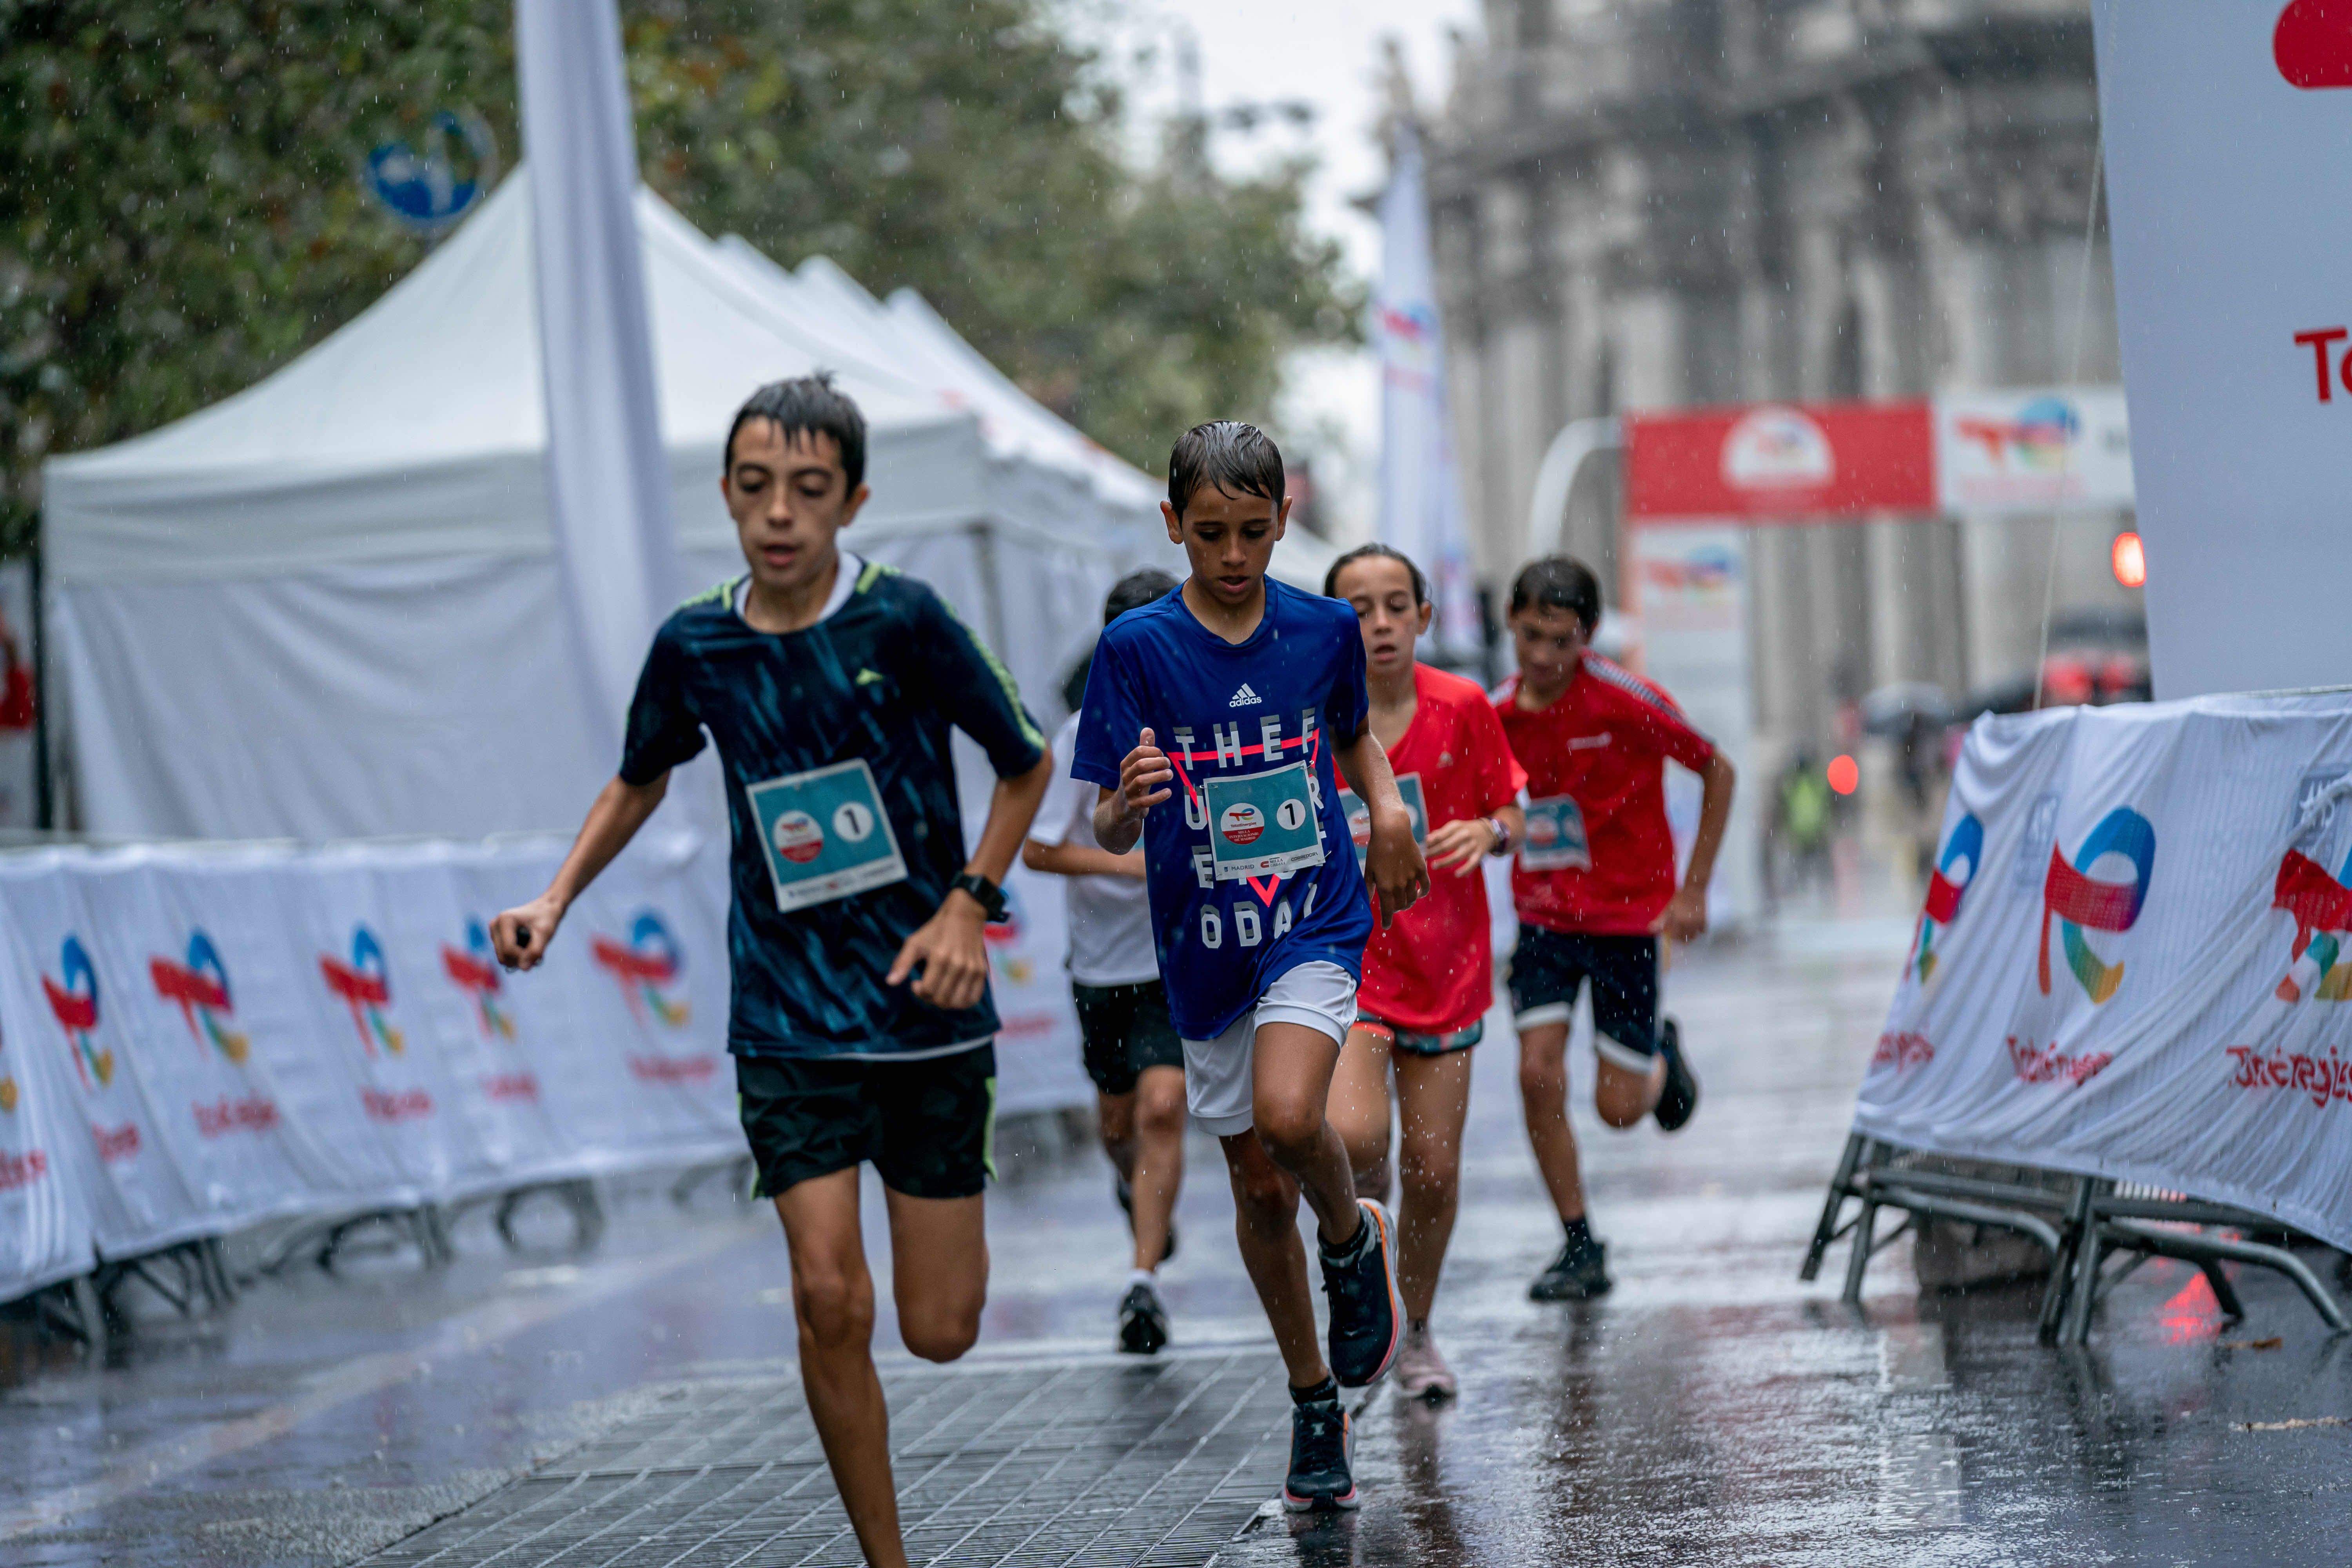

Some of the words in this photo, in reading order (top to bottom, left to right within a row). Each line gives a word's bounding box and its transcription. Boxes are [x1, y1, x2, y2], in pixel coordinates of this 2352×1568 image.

[2294, 328, 2352, 403] T
[1229, 697, 1262, 707] adidas
[844, 808, 860, 834] 1
[1285, 803, 1295, 826] 1
